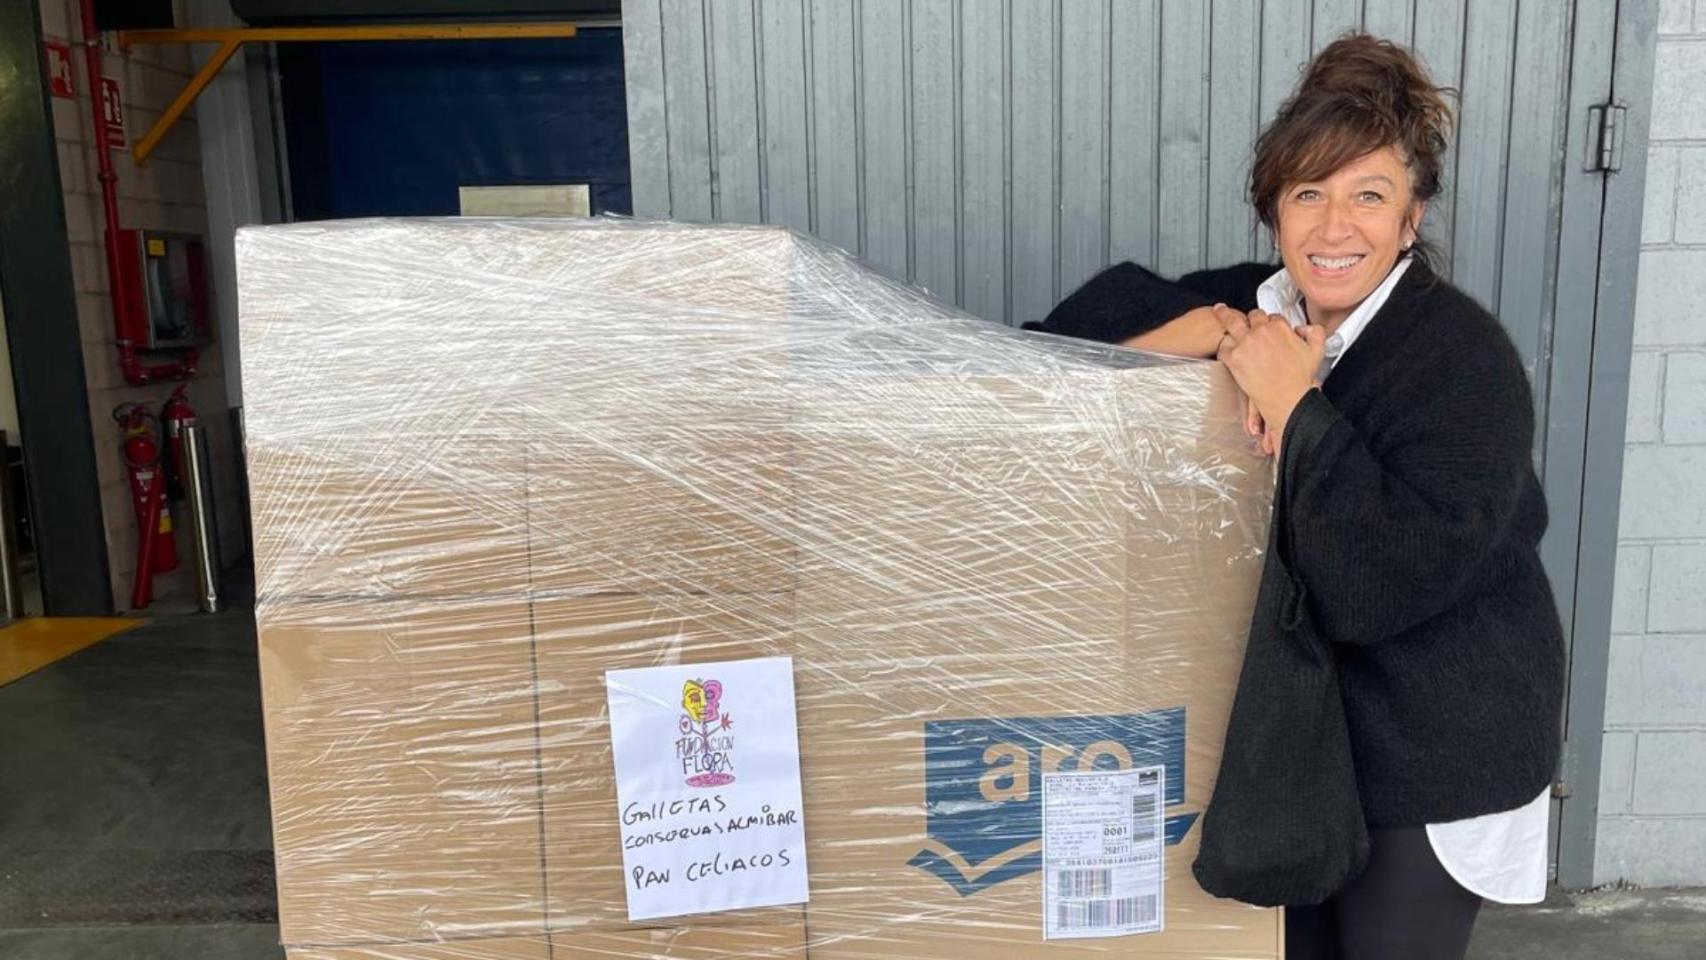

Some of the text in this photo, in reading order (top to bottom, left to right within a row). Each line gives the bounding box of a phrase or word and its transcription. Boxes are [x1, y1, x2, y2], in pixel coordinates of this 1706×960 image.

[682, 752, 734, 775] FLORA
[1104, 826, 1127, 836] 0001
[632, 865, 671, 890] PAN
